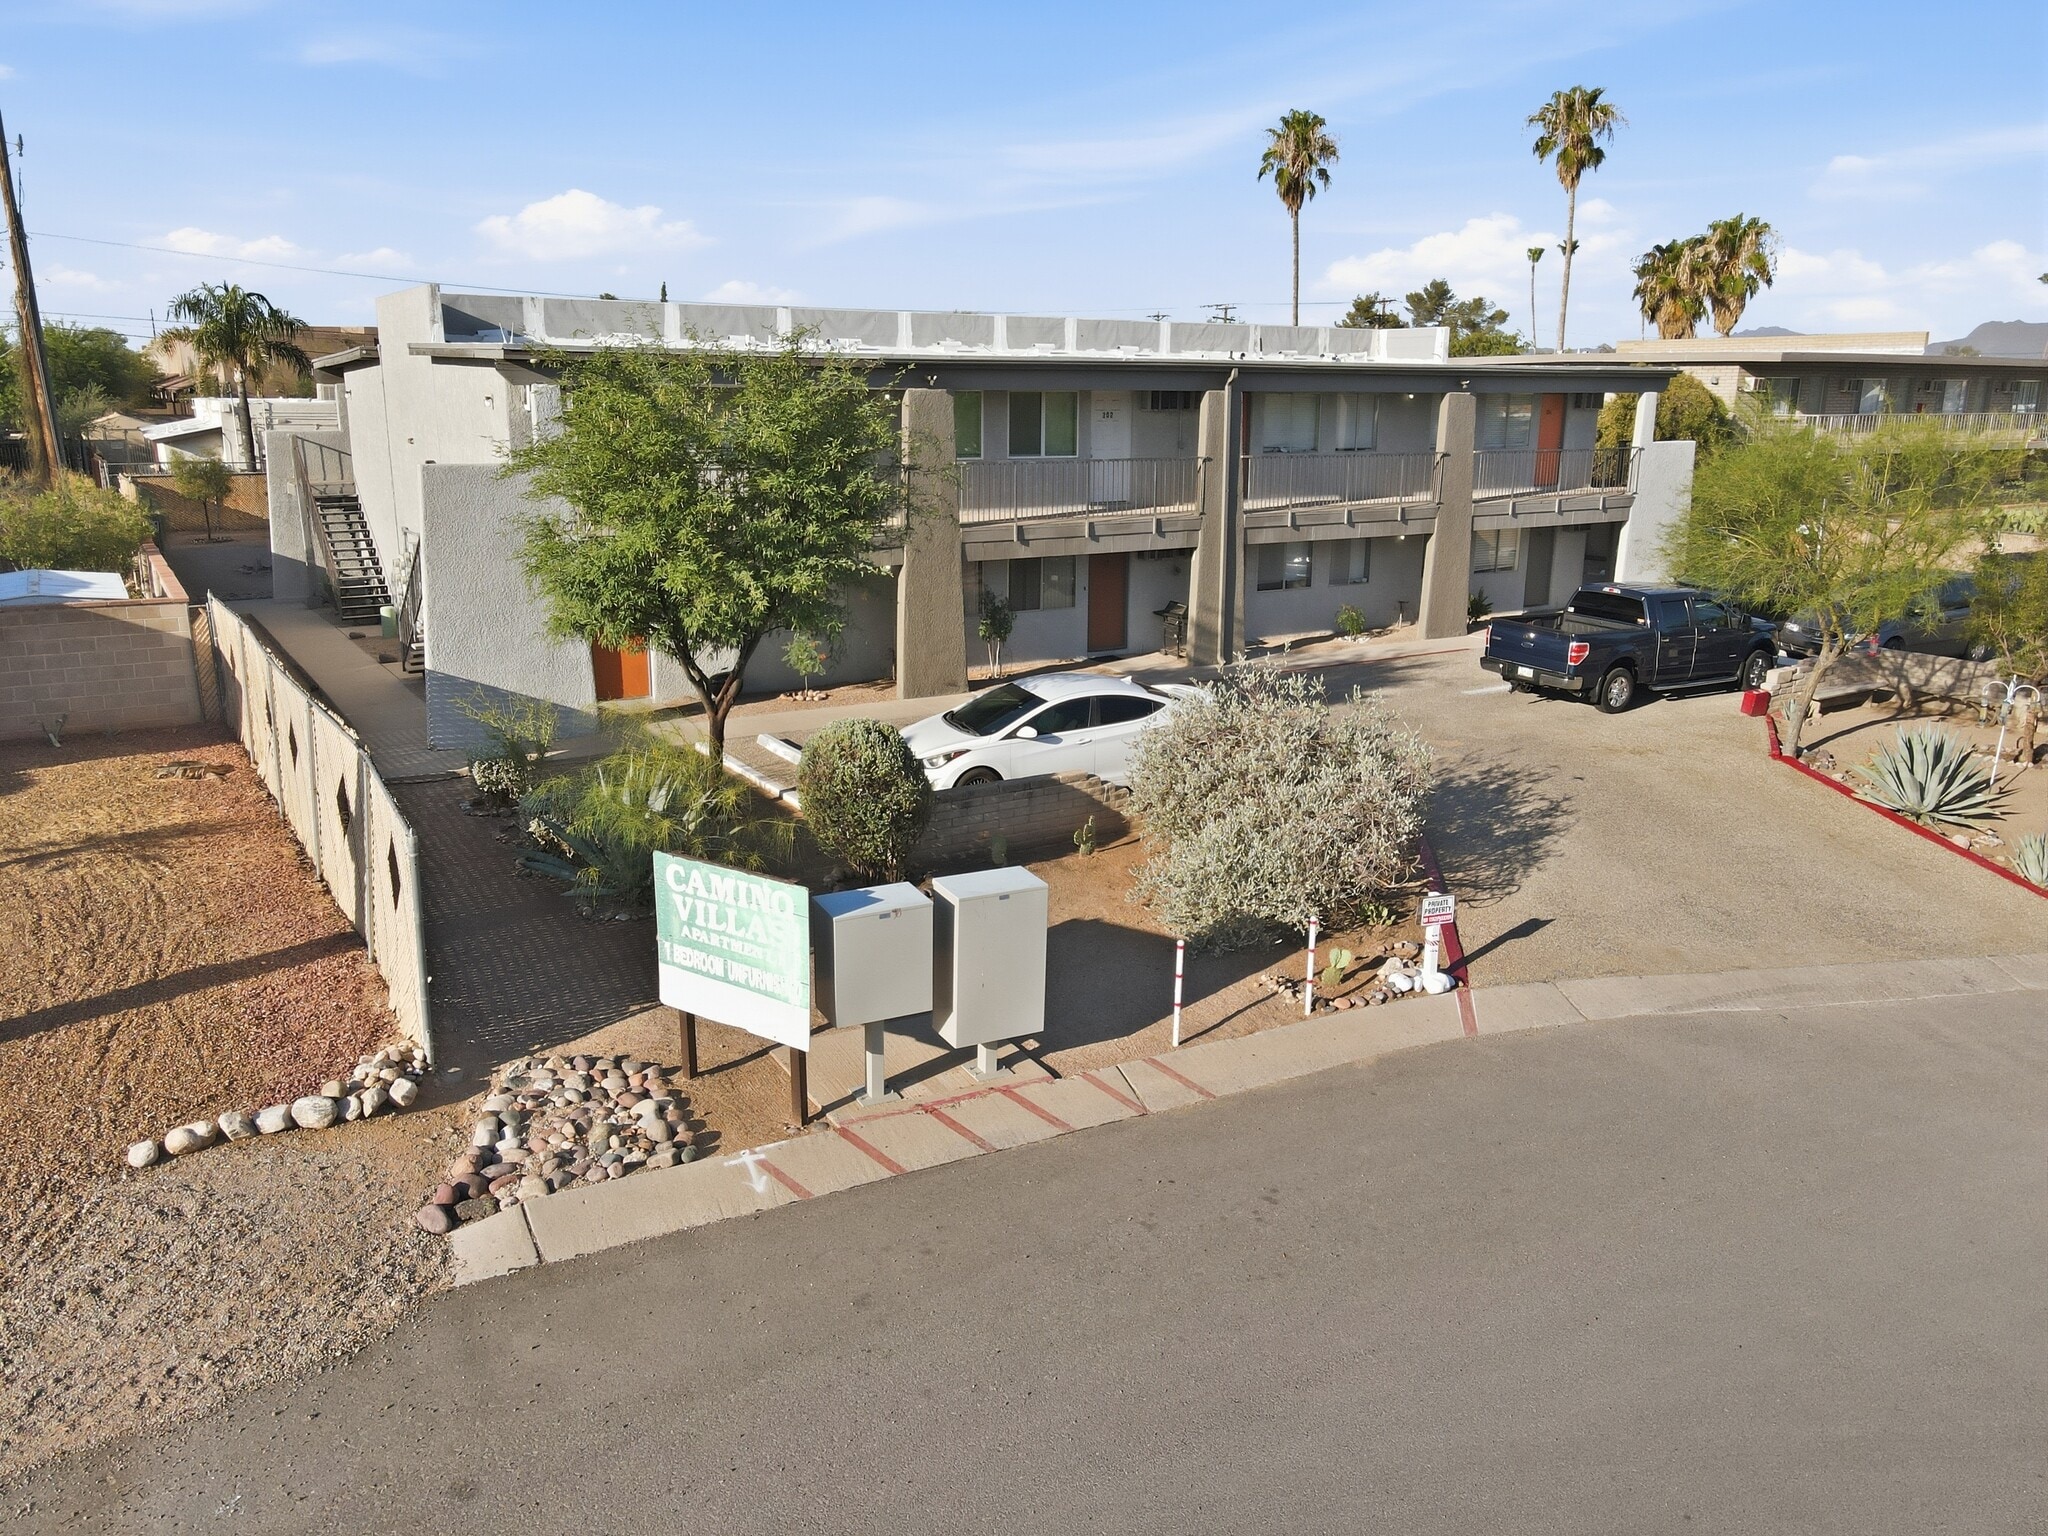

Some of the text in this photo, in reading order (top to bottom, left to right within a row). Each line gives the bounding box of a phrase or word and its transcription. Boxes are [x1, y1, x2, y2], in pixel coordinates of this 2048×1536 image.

[665, 863, 795, 918] CAMINO
[1428, 899, 1449, 907] PRIVATE
[1424, 906, 1452, 914] PROPERTY
[673, 943, 725, 978] BEDROOM
[681, 925, 782, 966] APARTMEN
